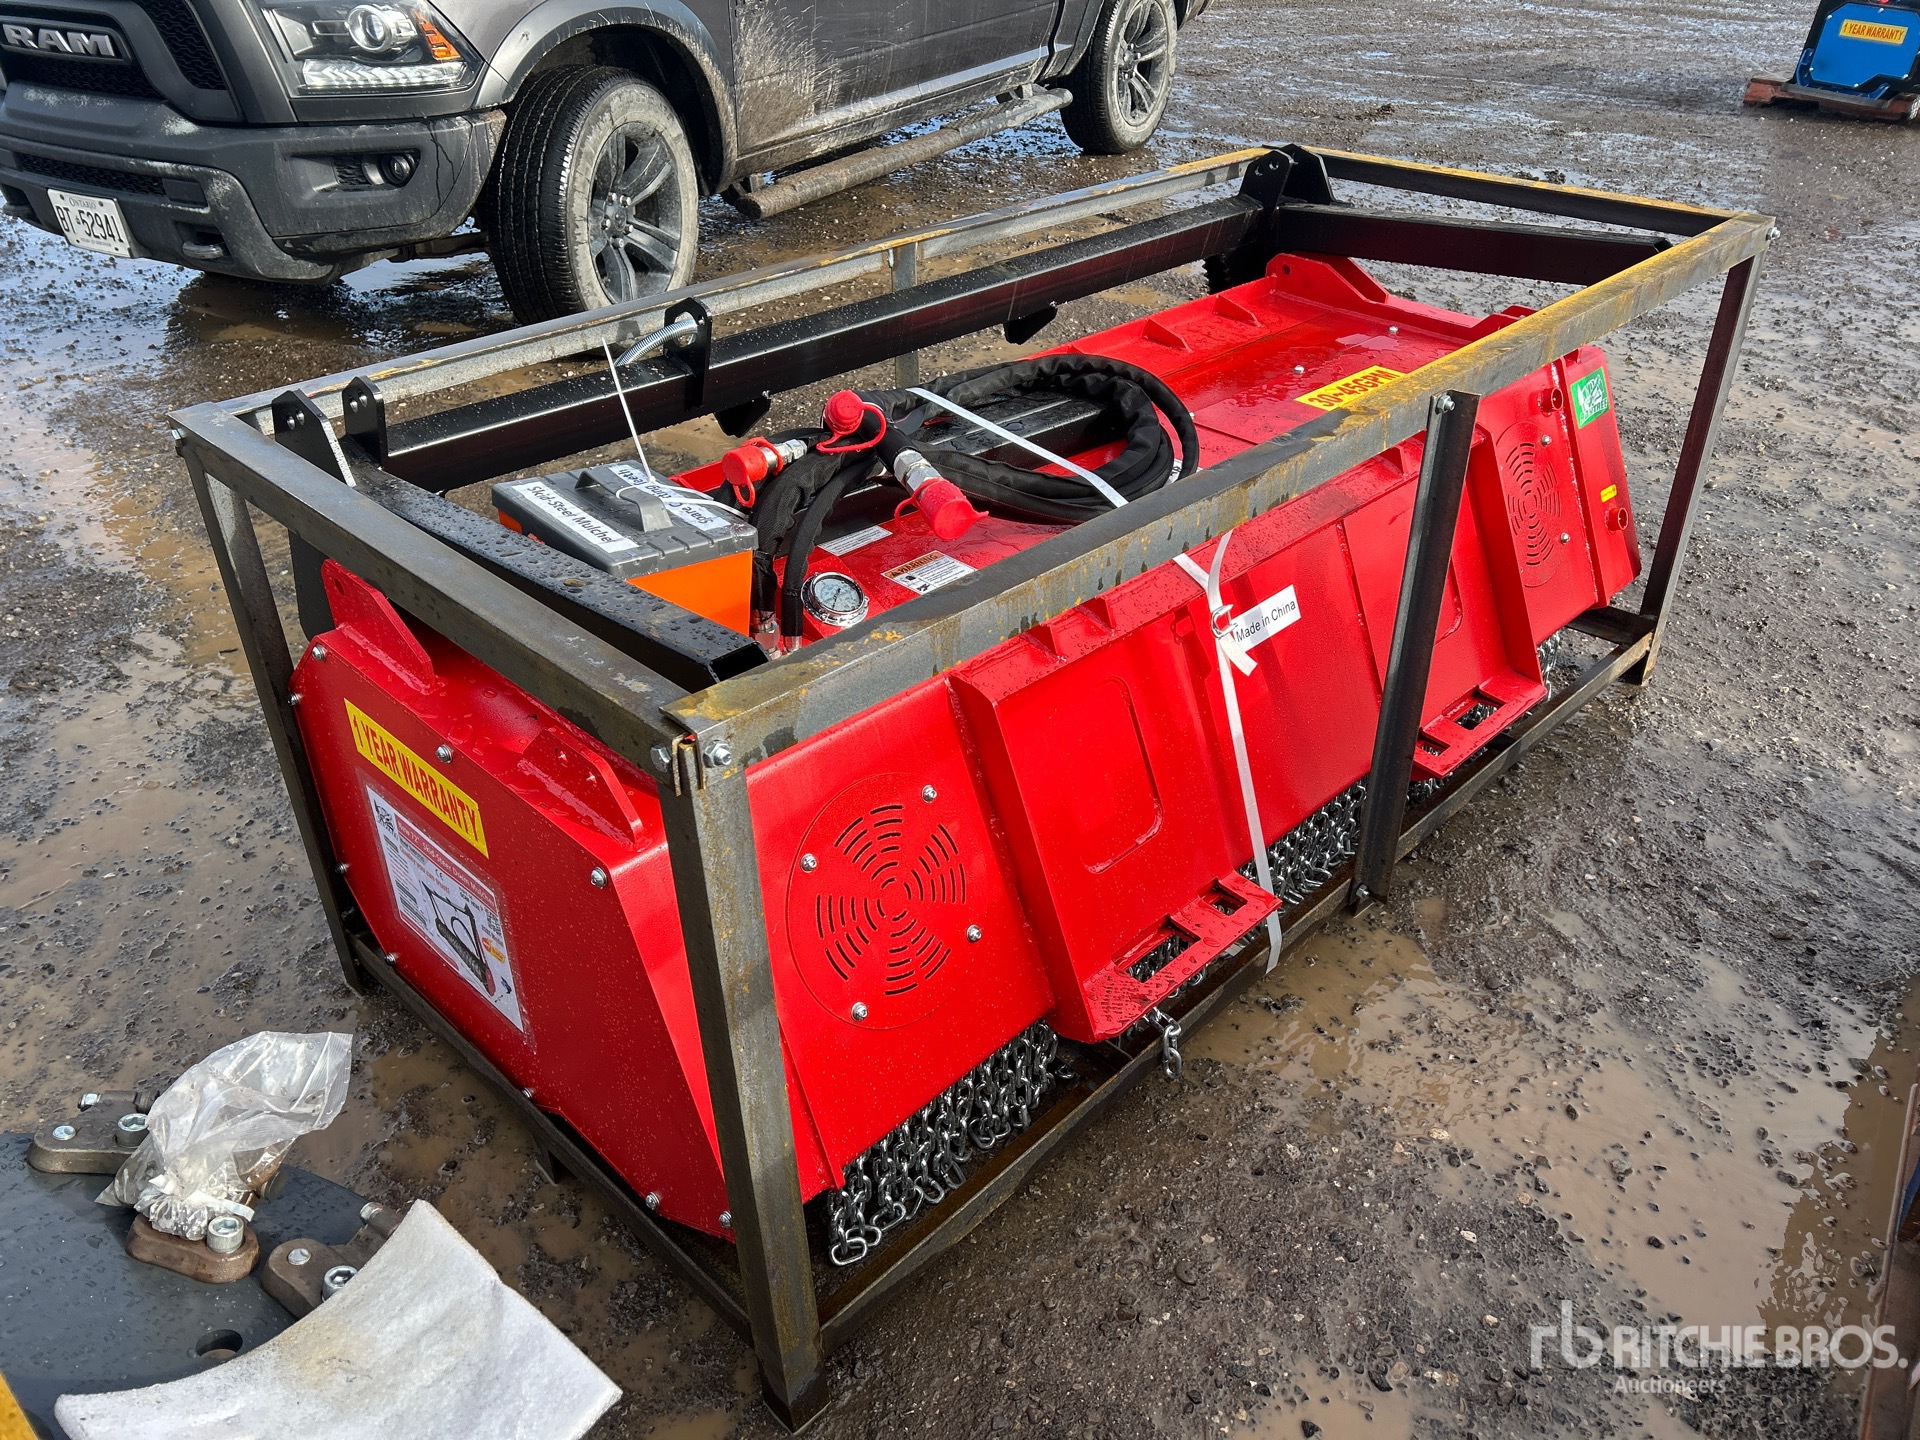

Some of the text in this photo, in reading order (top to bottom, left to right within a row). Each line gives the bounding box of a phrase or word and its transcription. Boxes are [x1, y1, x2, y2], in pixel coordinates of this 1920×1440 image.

[2, 23, 116, 57] RAM
[1843, 22, 1905, 41] 1 YEAR WARRANTY
[55, 205, 124, 243] BT 52941
[526, 485, 577, 518] Skid-Steer
[681, 505, 714, 525] Spare
[1235, 600, 1296, 643] Made in China
[353, 713, 479, 843] 1 YEAR WARRANTY
